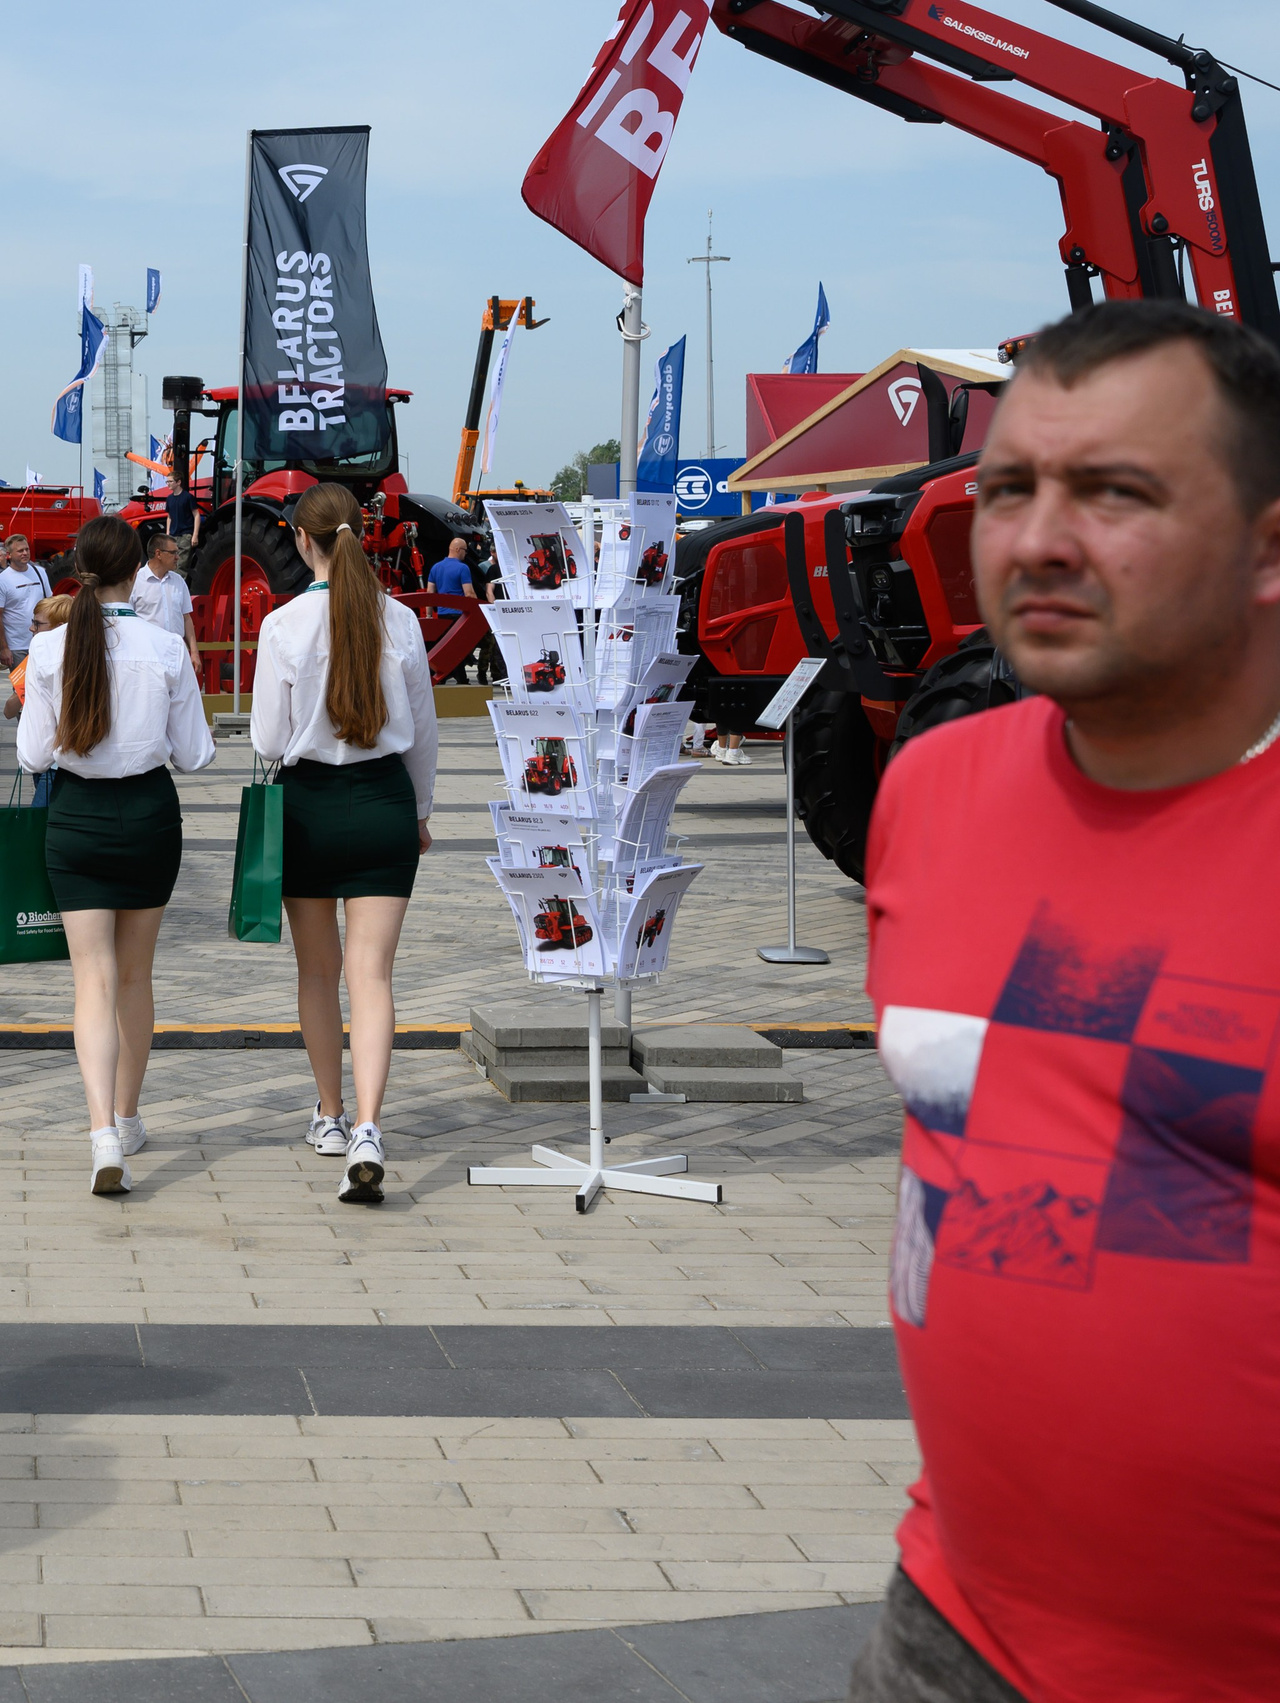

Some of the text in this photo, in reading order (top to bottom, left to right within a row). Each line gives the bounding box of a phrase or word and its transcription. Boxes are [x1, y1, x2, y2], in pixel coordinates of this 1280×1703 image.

[942, 15, 1030, 60] SALSKSELMASH
[272, 249, 315, 432] BELARUS
[304, 251, 346, 431] TRACTORS
